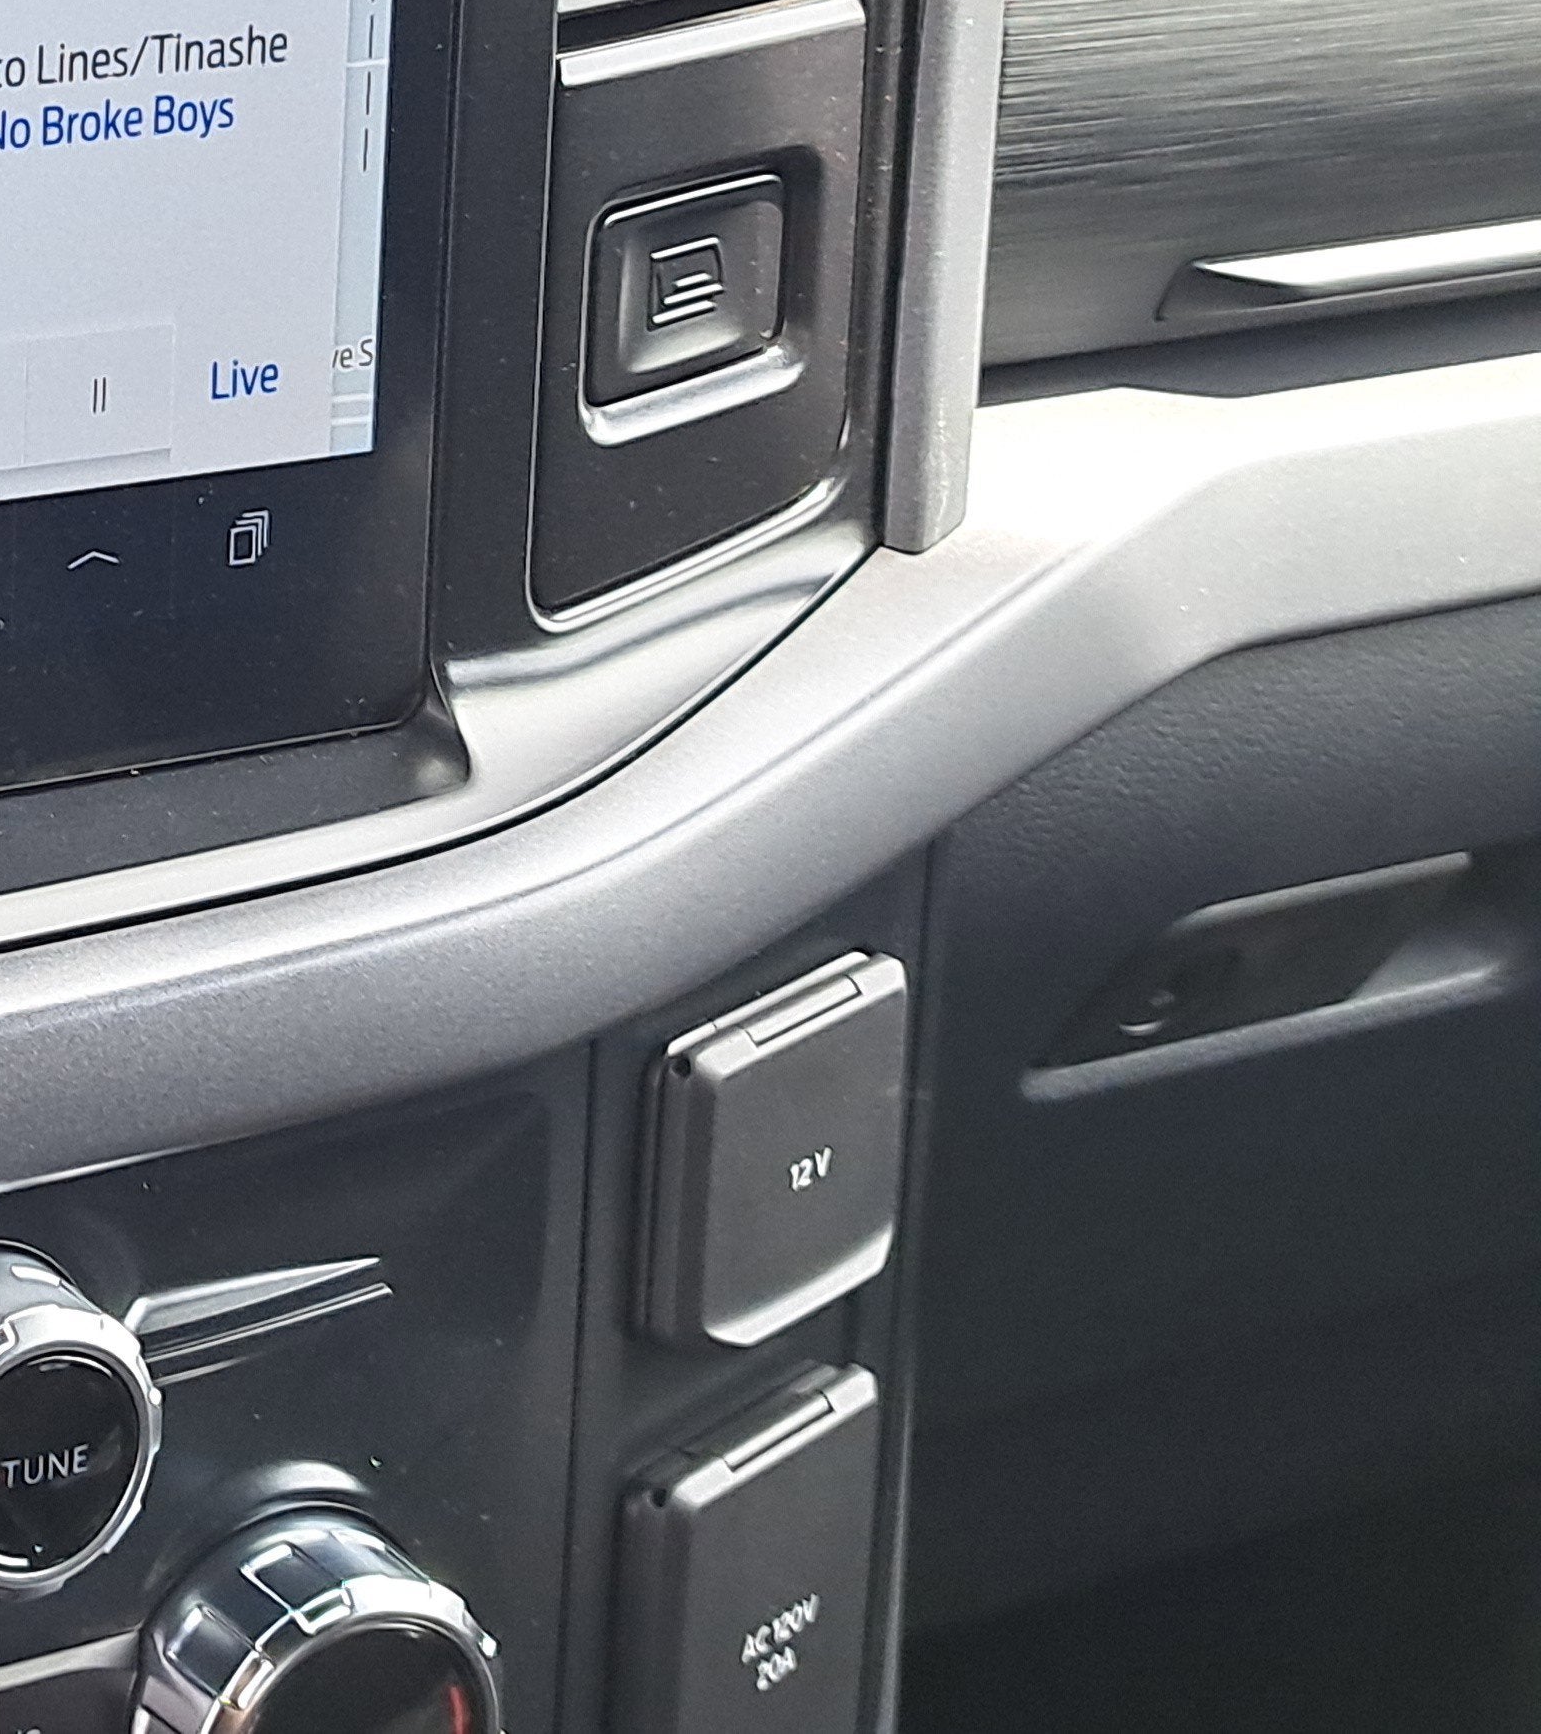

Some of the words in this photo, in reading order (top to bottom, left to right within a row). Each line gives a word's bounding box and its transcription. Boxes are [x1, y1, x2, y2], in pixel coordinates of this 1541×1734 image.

[36, 24, 290, 87] Lines/Tinashe
[41, 98, 144, 147] Broke
[152, 92, 236, 137] Boys
[210, 359, 280, 401] Live
[0, 1444, 90, 1490] TUNE
